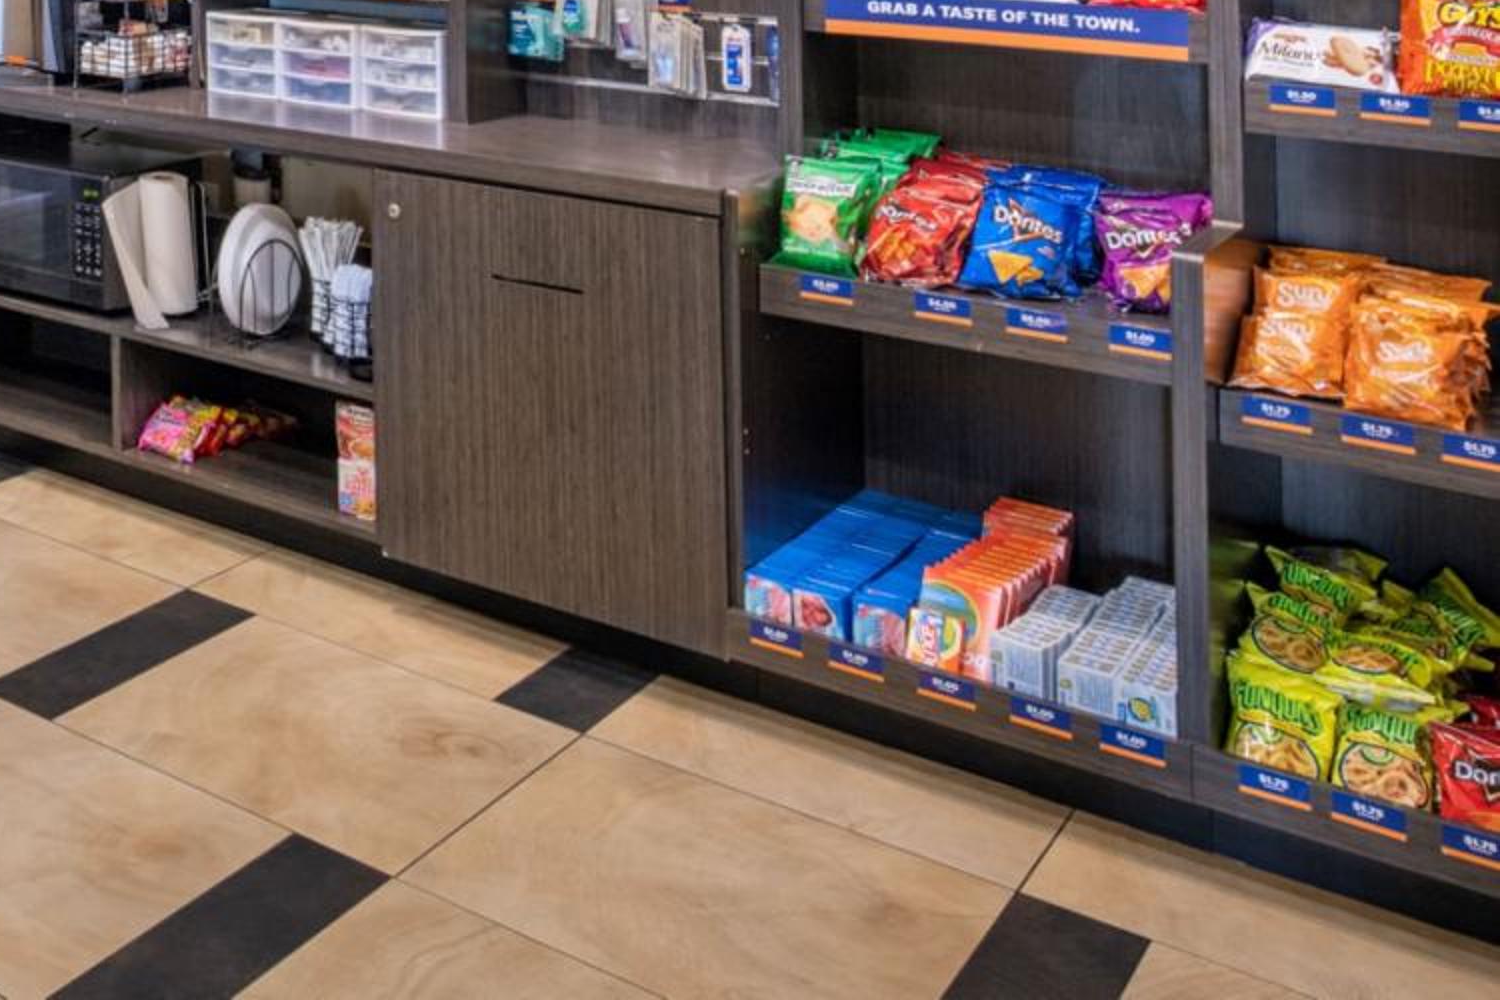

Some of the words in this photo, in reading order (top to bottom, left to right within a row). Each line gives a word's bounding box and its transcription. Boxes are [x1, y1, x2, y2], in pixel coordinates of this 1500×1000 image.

[867, 0, 918, 16] GRAB
[921, 4, 934, 18] A
[939, 5, 997, 22] TASTE
[1002, 9, 1027, 24] OF
[1030, 11, 1070, 27] THE
[1073, 15, 1140, 33] TOWN.
[994, 205, 1063, 244] Doritos
